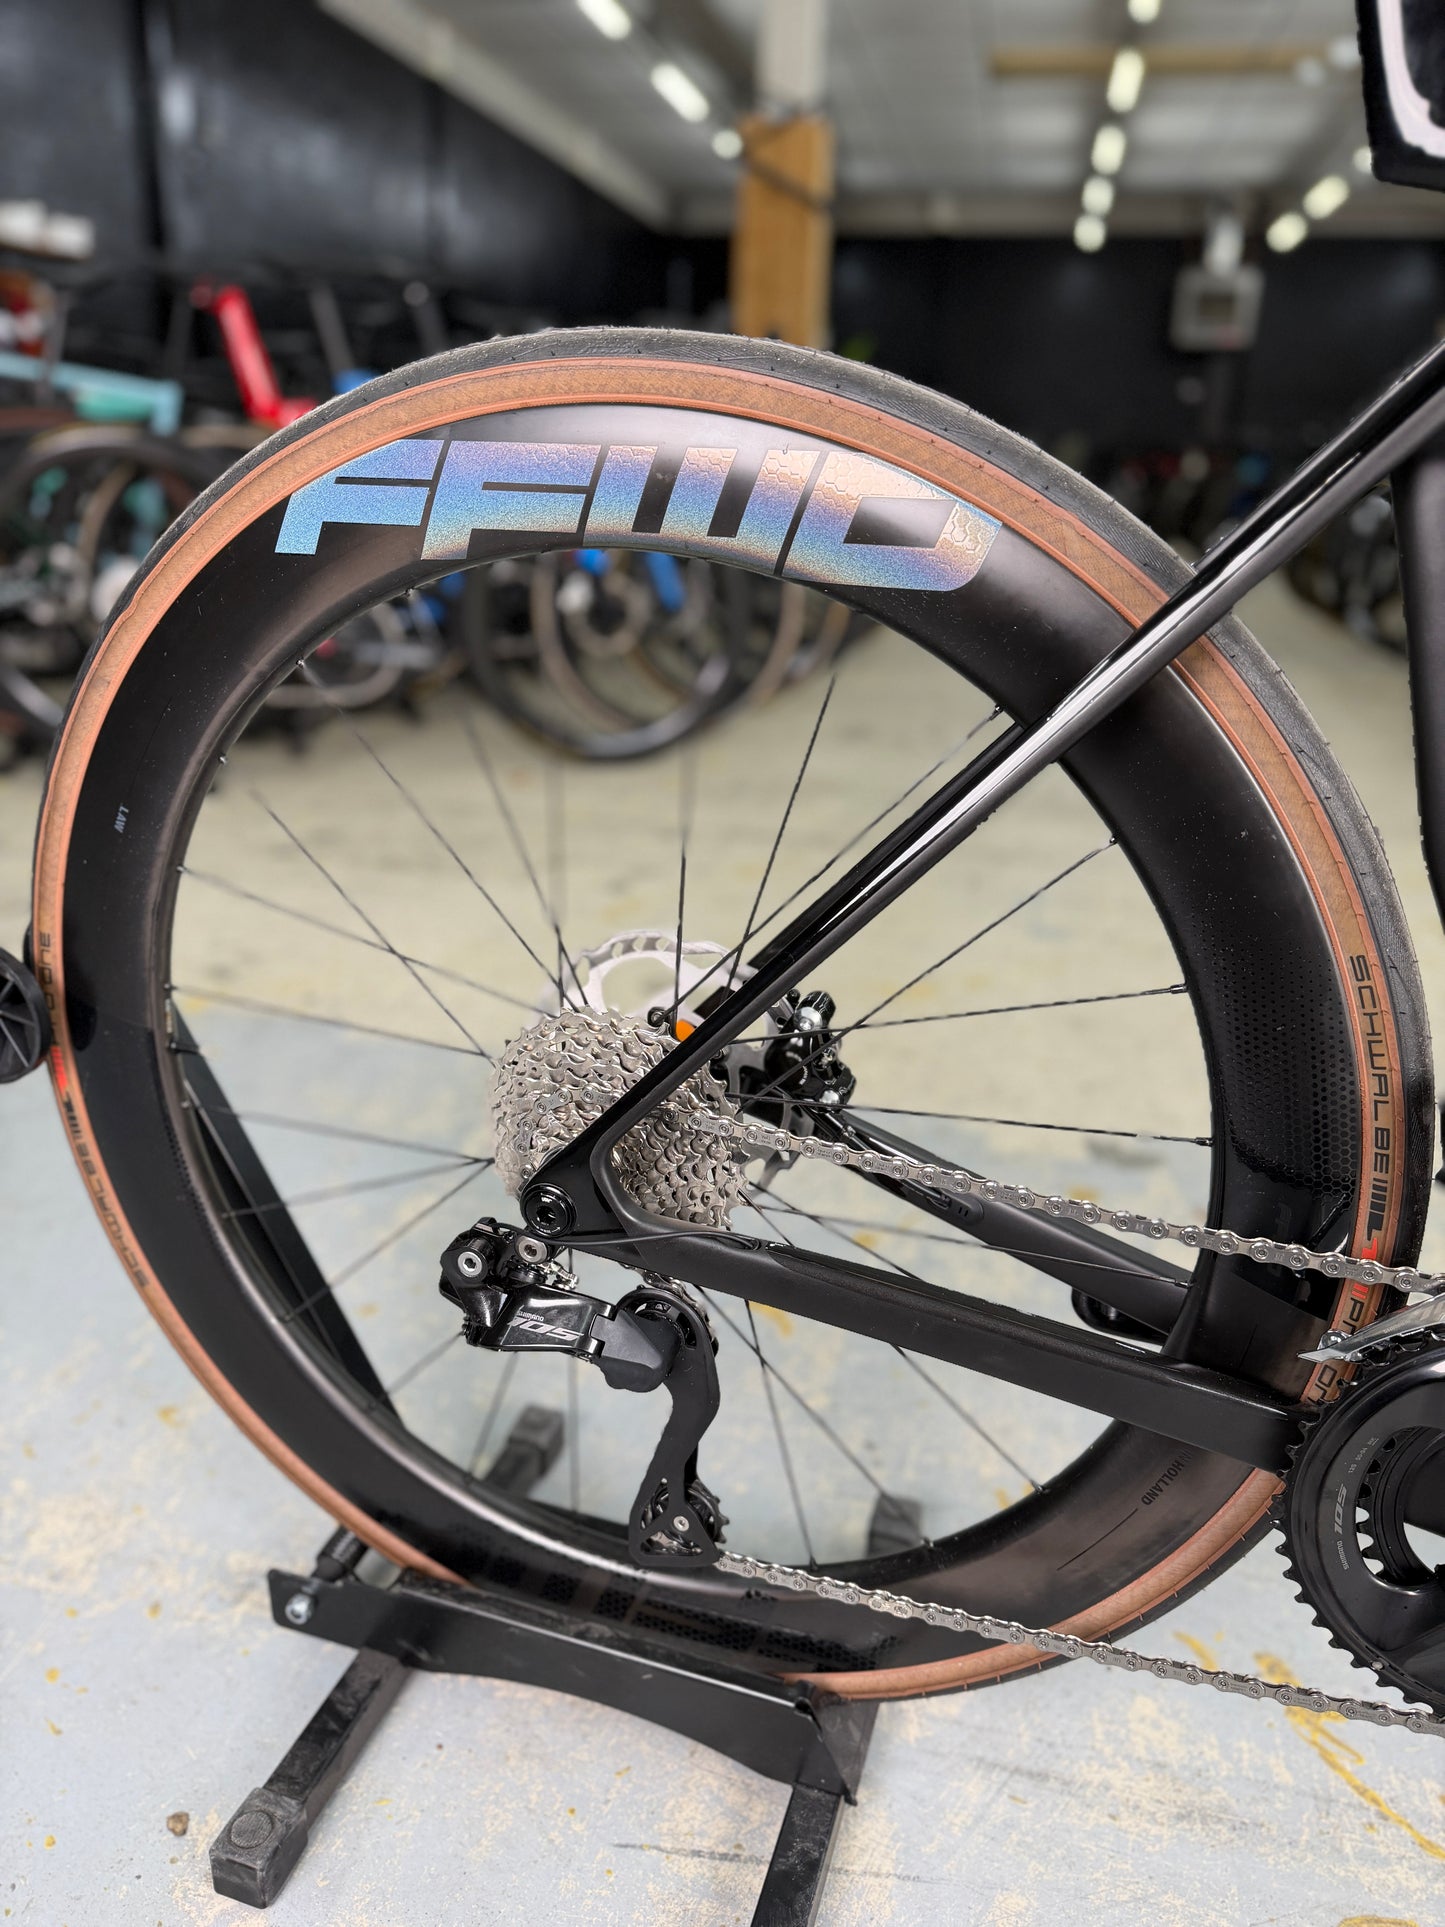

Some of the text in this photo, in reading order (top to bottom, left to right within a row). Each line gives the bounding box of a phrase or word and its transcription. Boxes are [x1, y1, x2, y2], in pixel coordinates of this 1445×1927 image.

[274, 439, 1003, 591] FFWD
[1350, 954, 1391, 1165] SCHWALBE
[507, 1317, 584, 1341] 105
[1140, 1459, 1185, 1506] HOLLAND
[1334, 1483, 1350, 1571] SHIMANO 105
